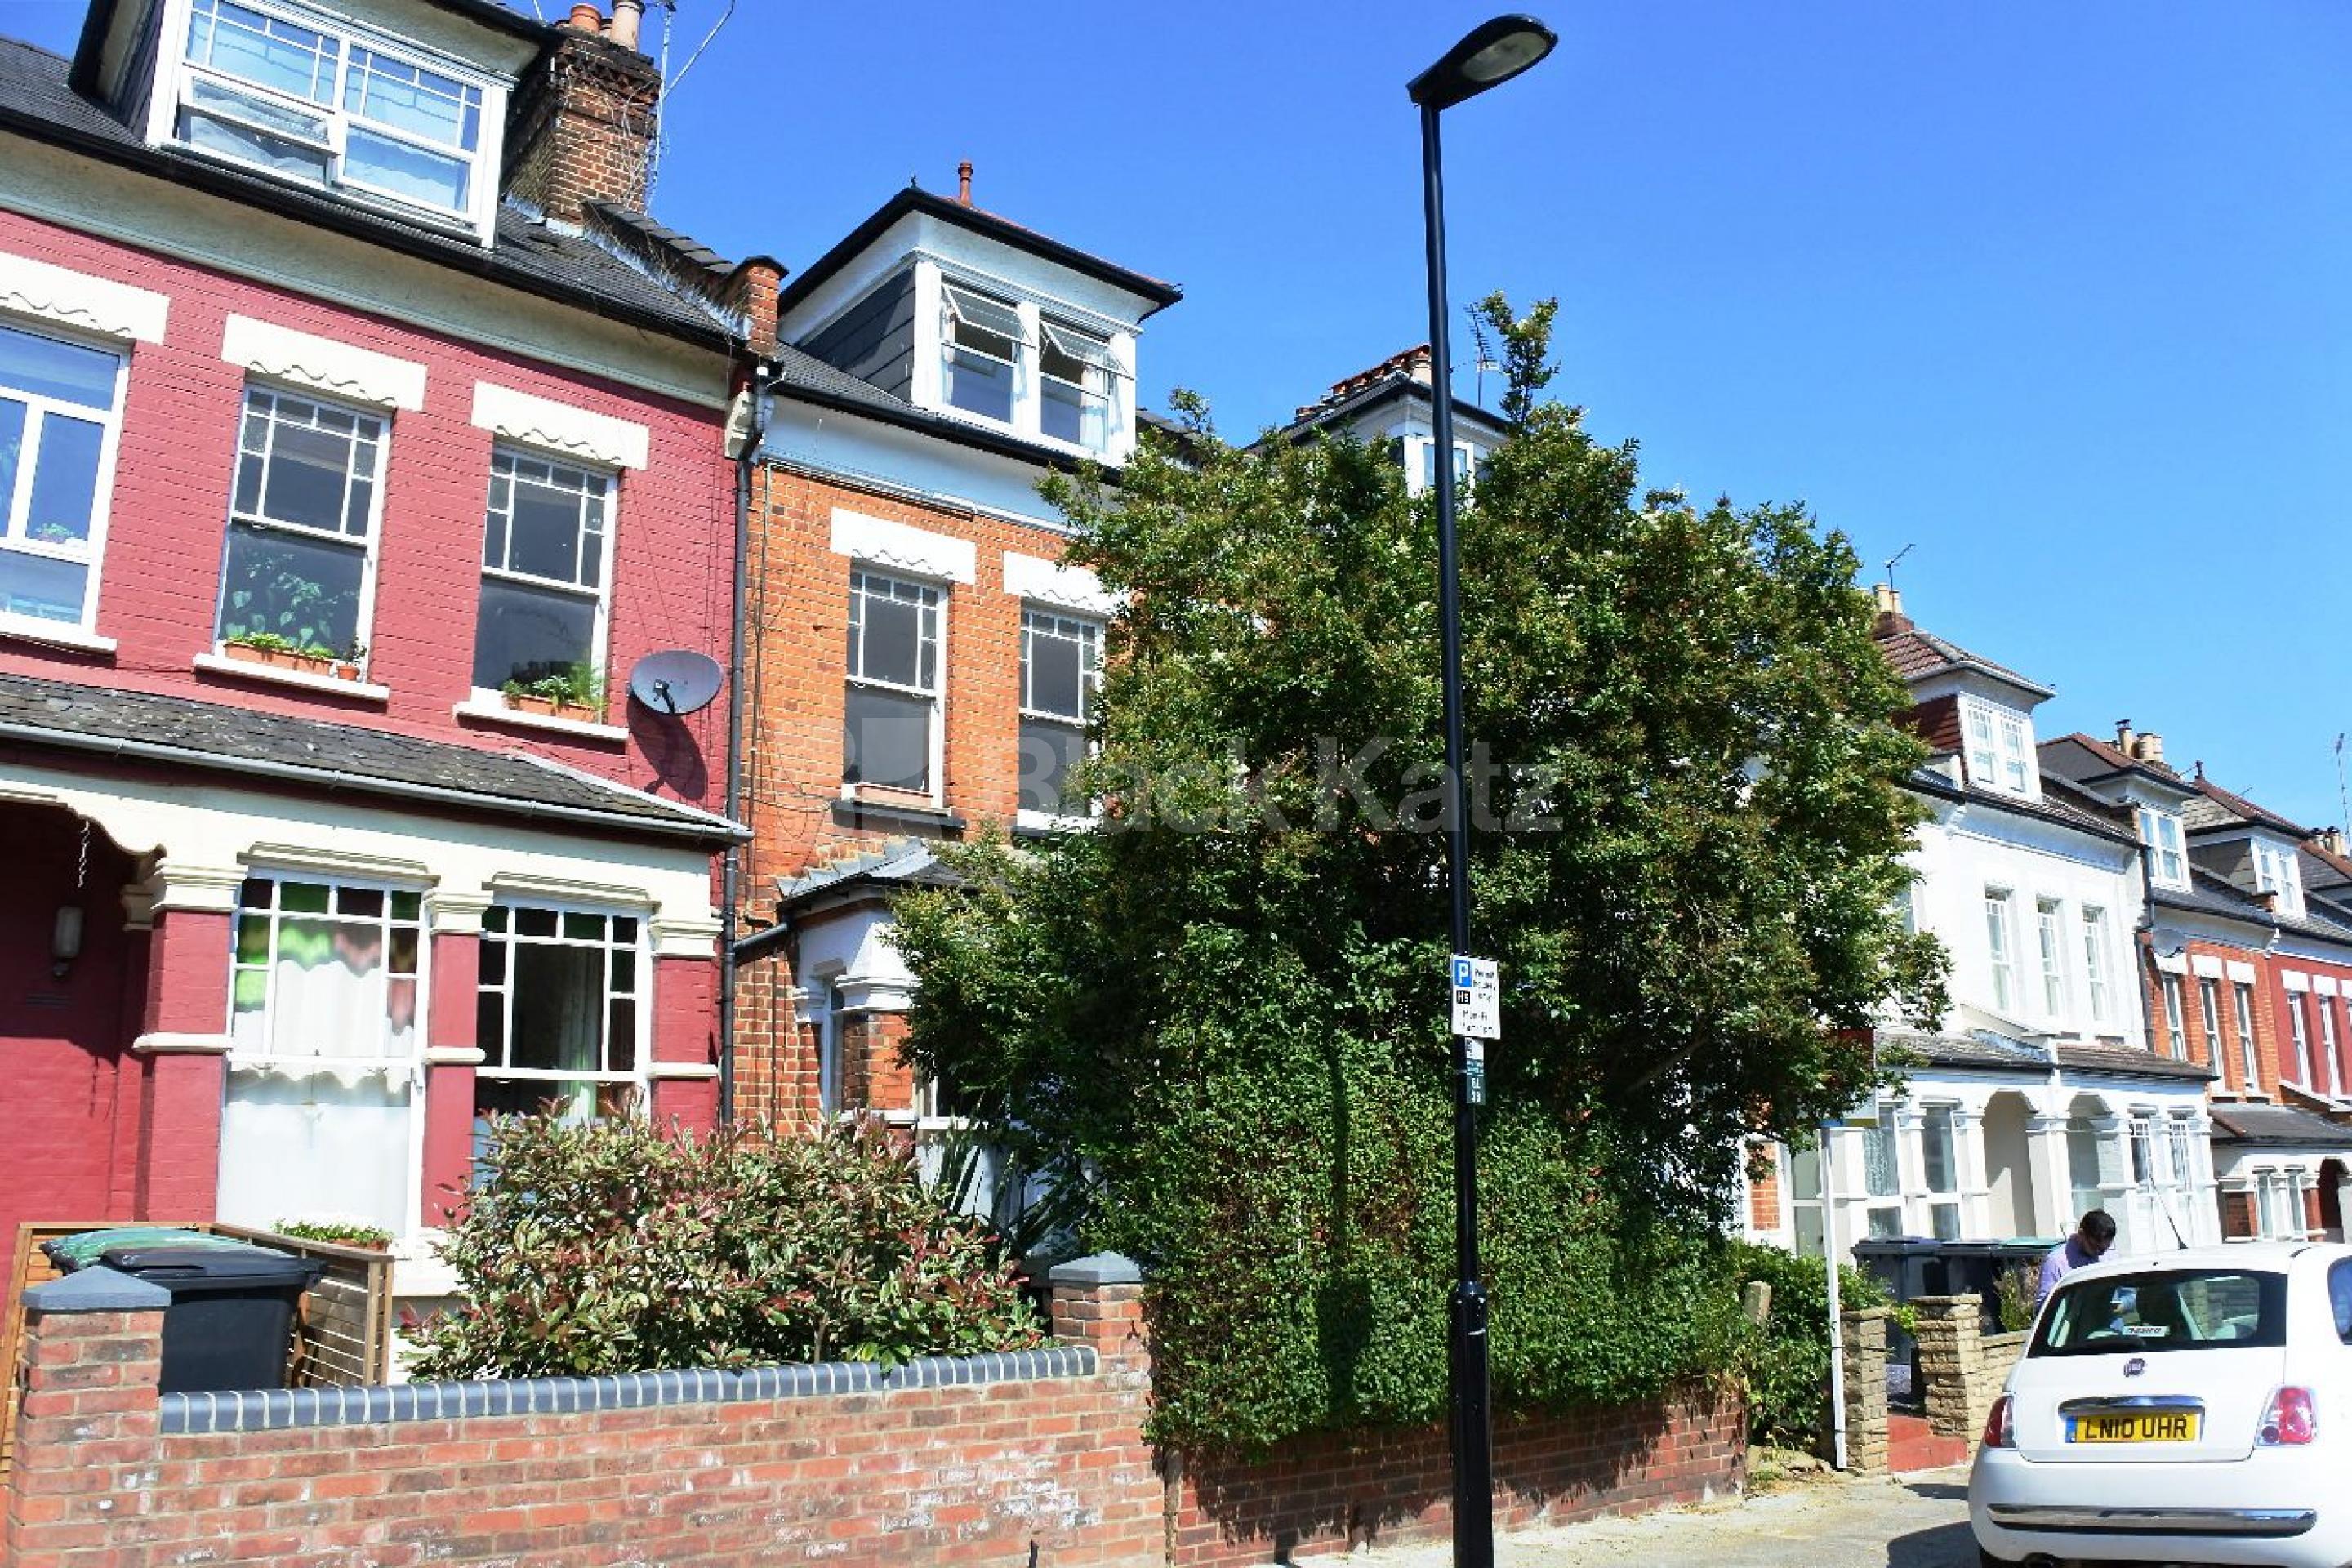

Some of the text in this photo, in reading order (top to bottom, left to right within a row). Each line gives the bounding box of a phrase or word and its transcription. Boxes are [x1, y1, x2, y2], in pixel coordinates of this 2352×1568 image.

[1458, 962, 1469, 983] P
[2084, 1417, 2188, 1439] LN10 UHR
